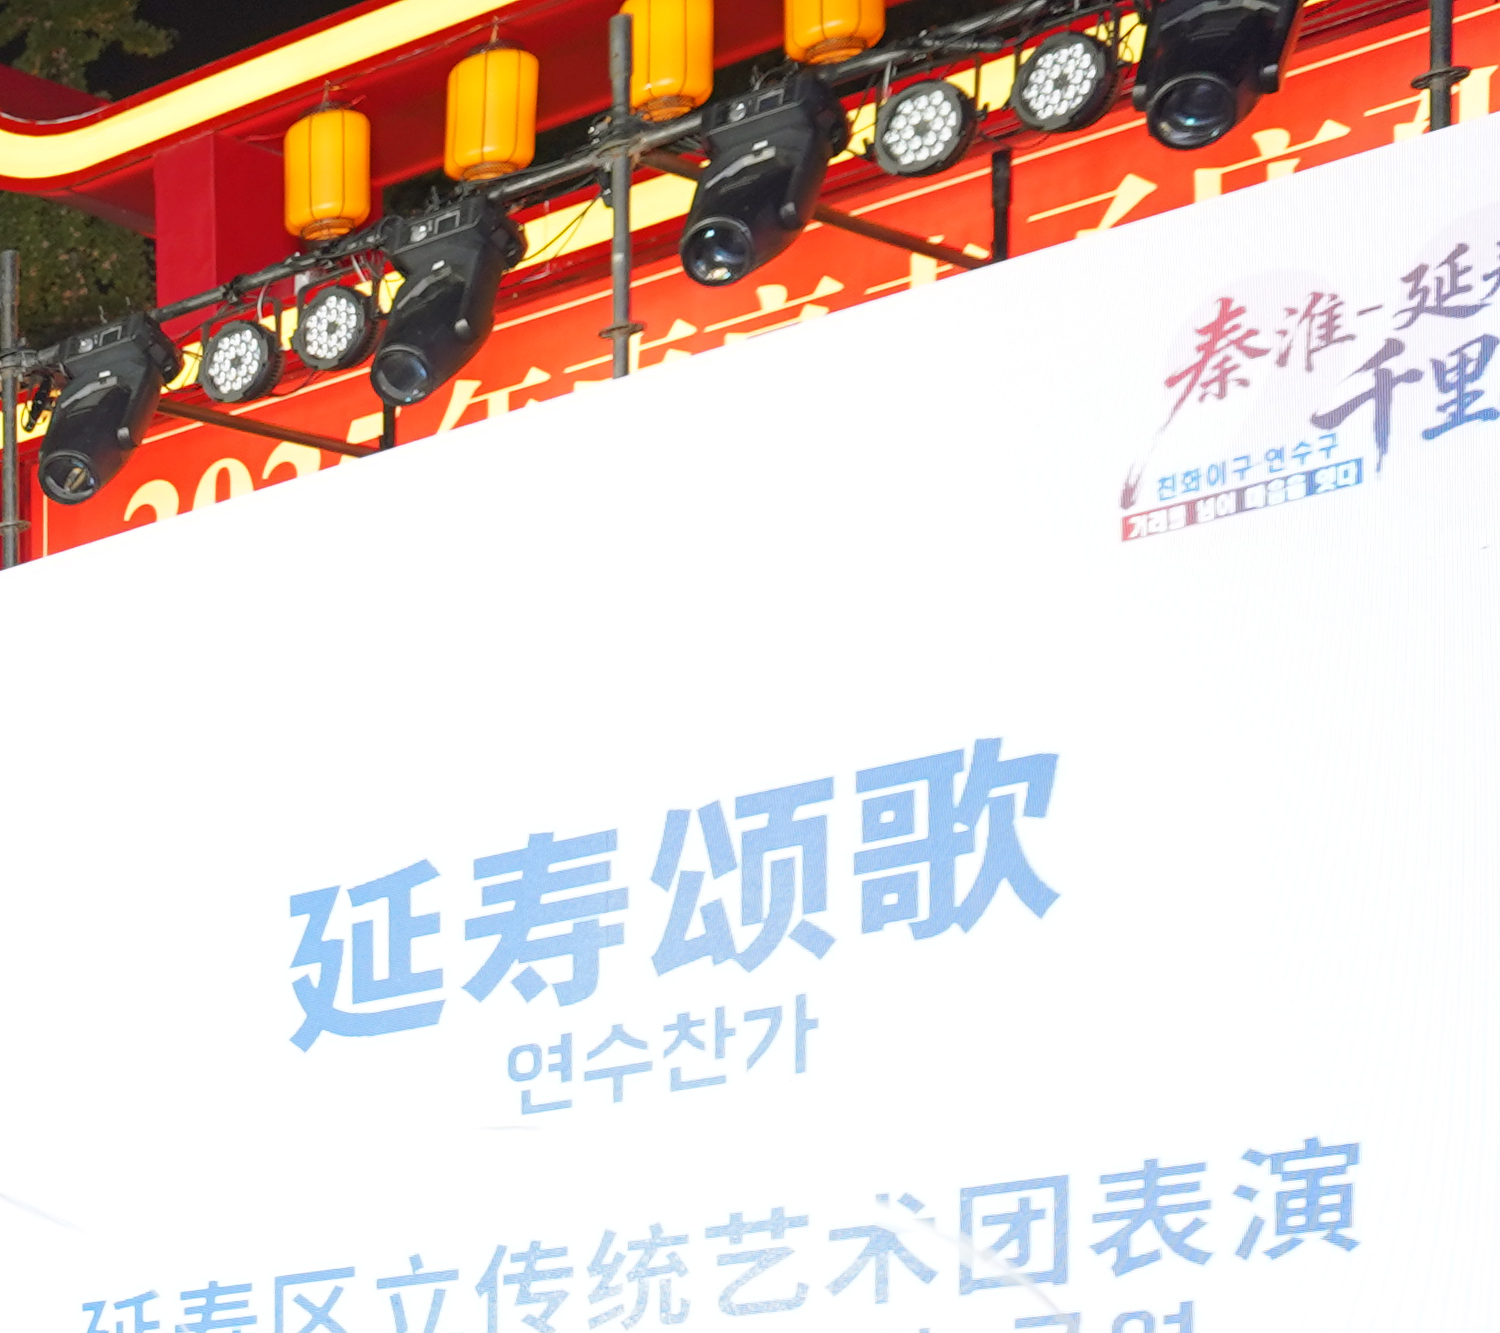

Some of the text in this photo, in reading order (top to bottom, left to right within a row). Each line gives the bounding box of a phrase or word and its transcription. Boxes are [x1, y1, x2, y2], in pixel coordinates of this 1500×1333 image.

[1155, 243, 1500, 450] 秦淮-延
[290, 738, 1060, 1052] 延寿颂歌
[507, 994, 819, 1115] 연수찬가
